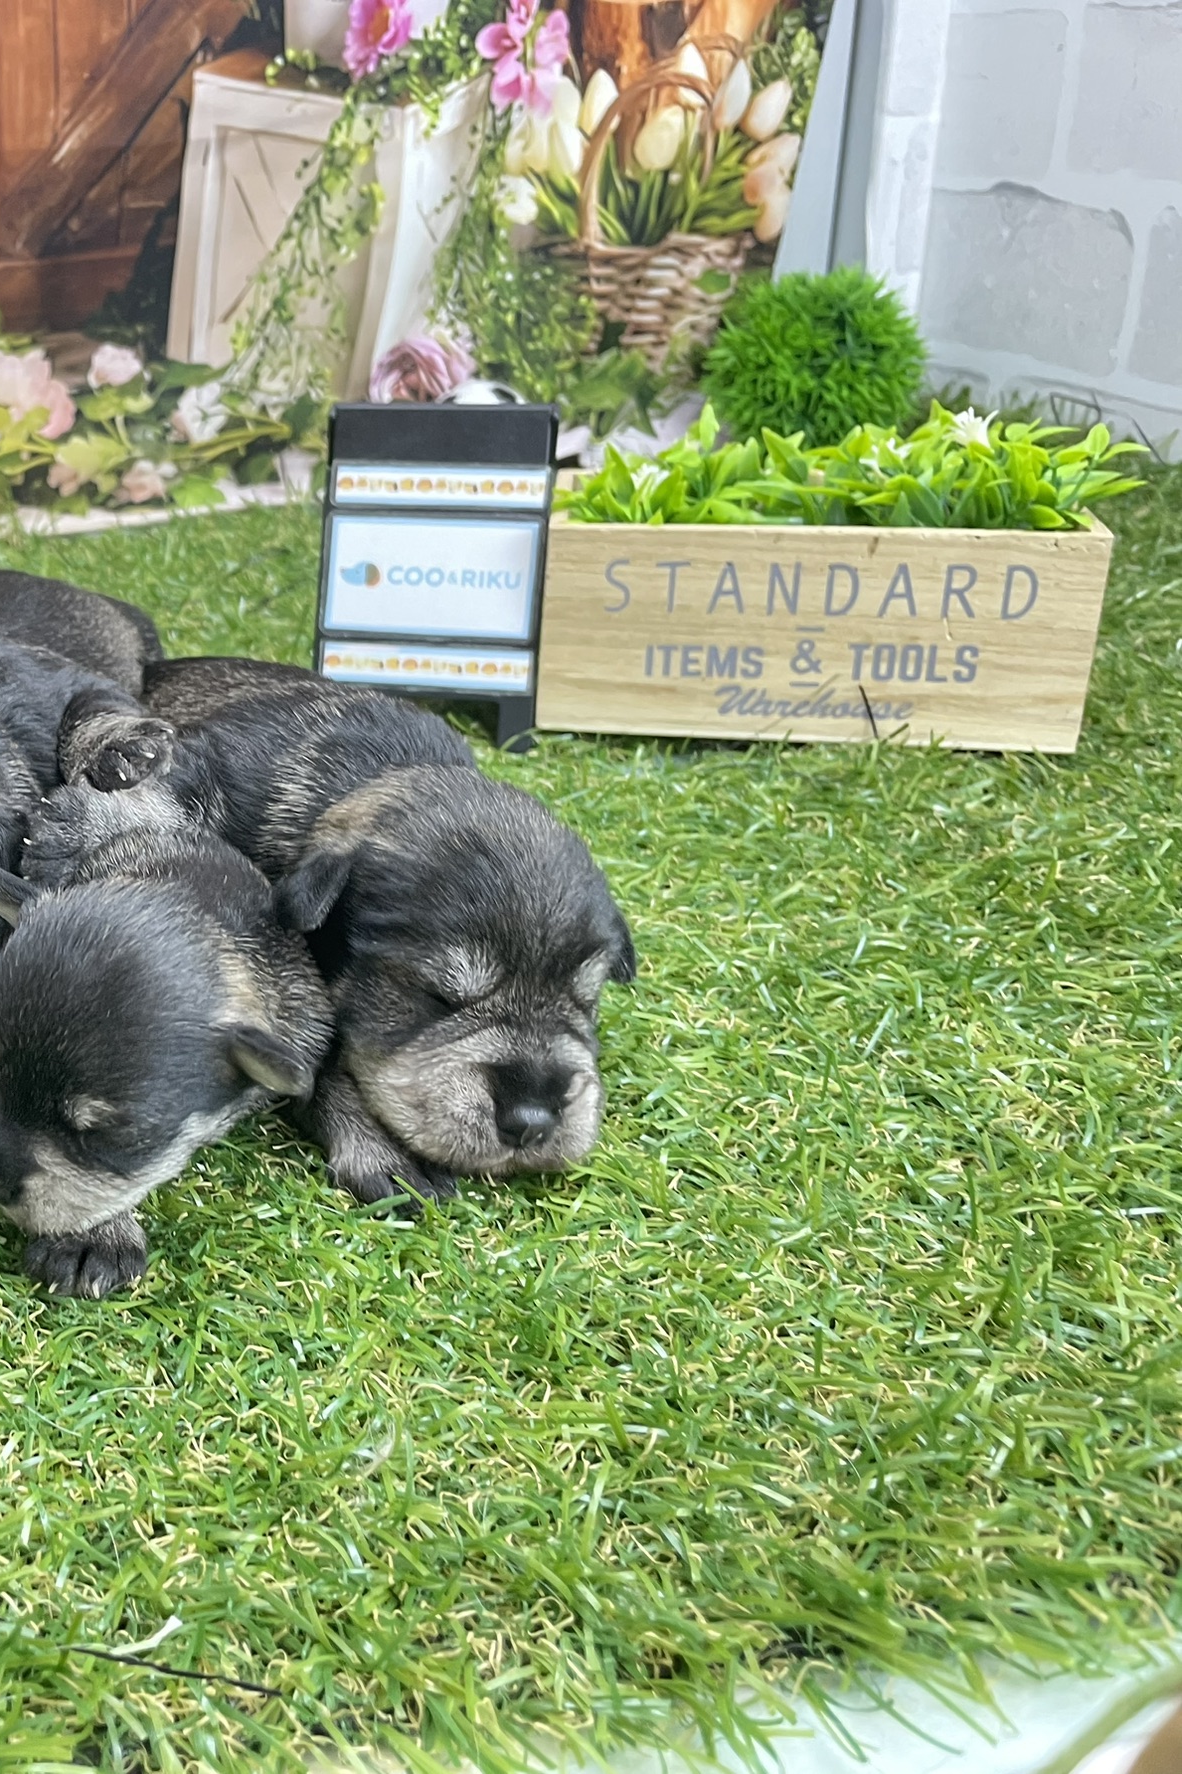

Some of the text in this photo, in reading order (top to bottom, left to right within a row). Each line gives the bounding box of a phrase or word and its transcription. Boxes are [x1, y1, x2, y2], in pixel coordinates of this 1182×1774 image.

[603, 559, 1040, 620] STANDARD
[644, 638, 979, 683] ITEMS & TOOLS
[714, 685, 915, 720] Warehouse
